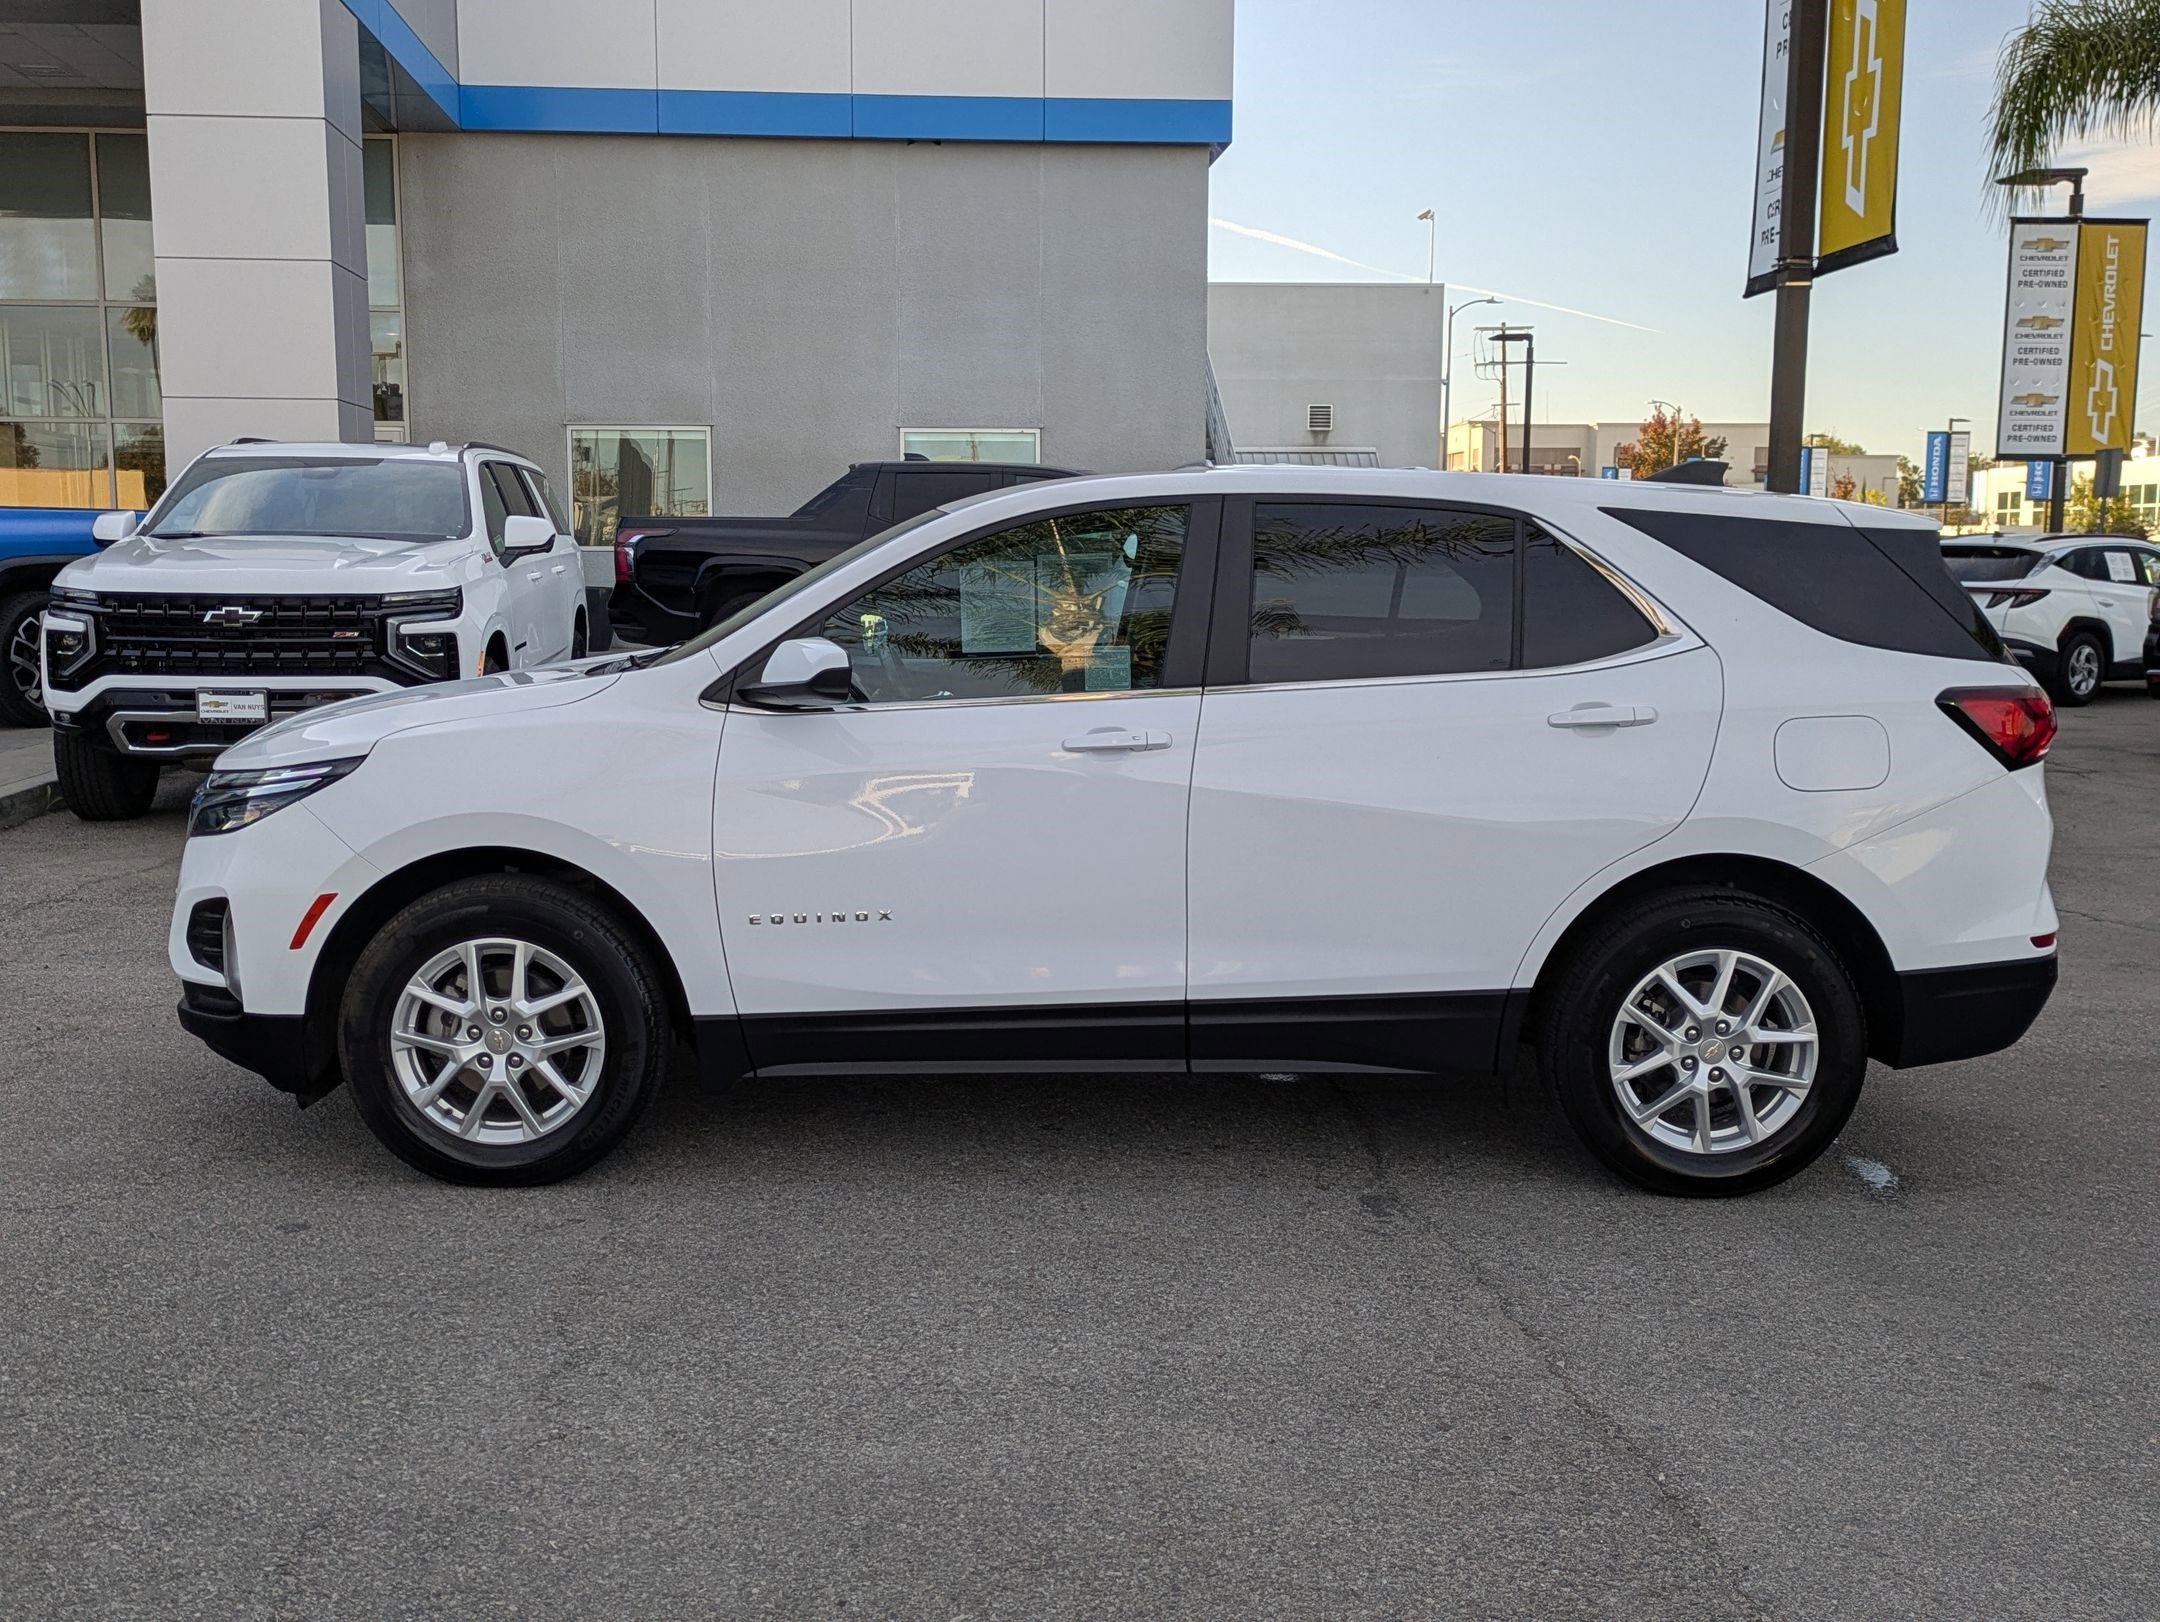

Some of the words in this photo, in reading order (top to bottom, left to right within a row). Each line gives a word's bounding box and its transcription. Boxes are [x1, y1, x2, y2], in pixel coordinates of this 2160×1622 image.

[2022, 269, 2065, 277] CERTIFIED
[2017, 280, 2068, 288] PRE-OWNED
[2101, 234, 2120, 351] CHEVROLET
[2017, 347, 2060, 355] CERTIFIED
[2012, 358, 2063, 366] PRE-OWNED
[2011, 424, 2054, 432] CERTIFIED
[2006, 434, 2058, 443] PRE-OWNED
[1931, 435, 1942, 487] HONDA
[748, 909, 892, 925] EQUINOX
